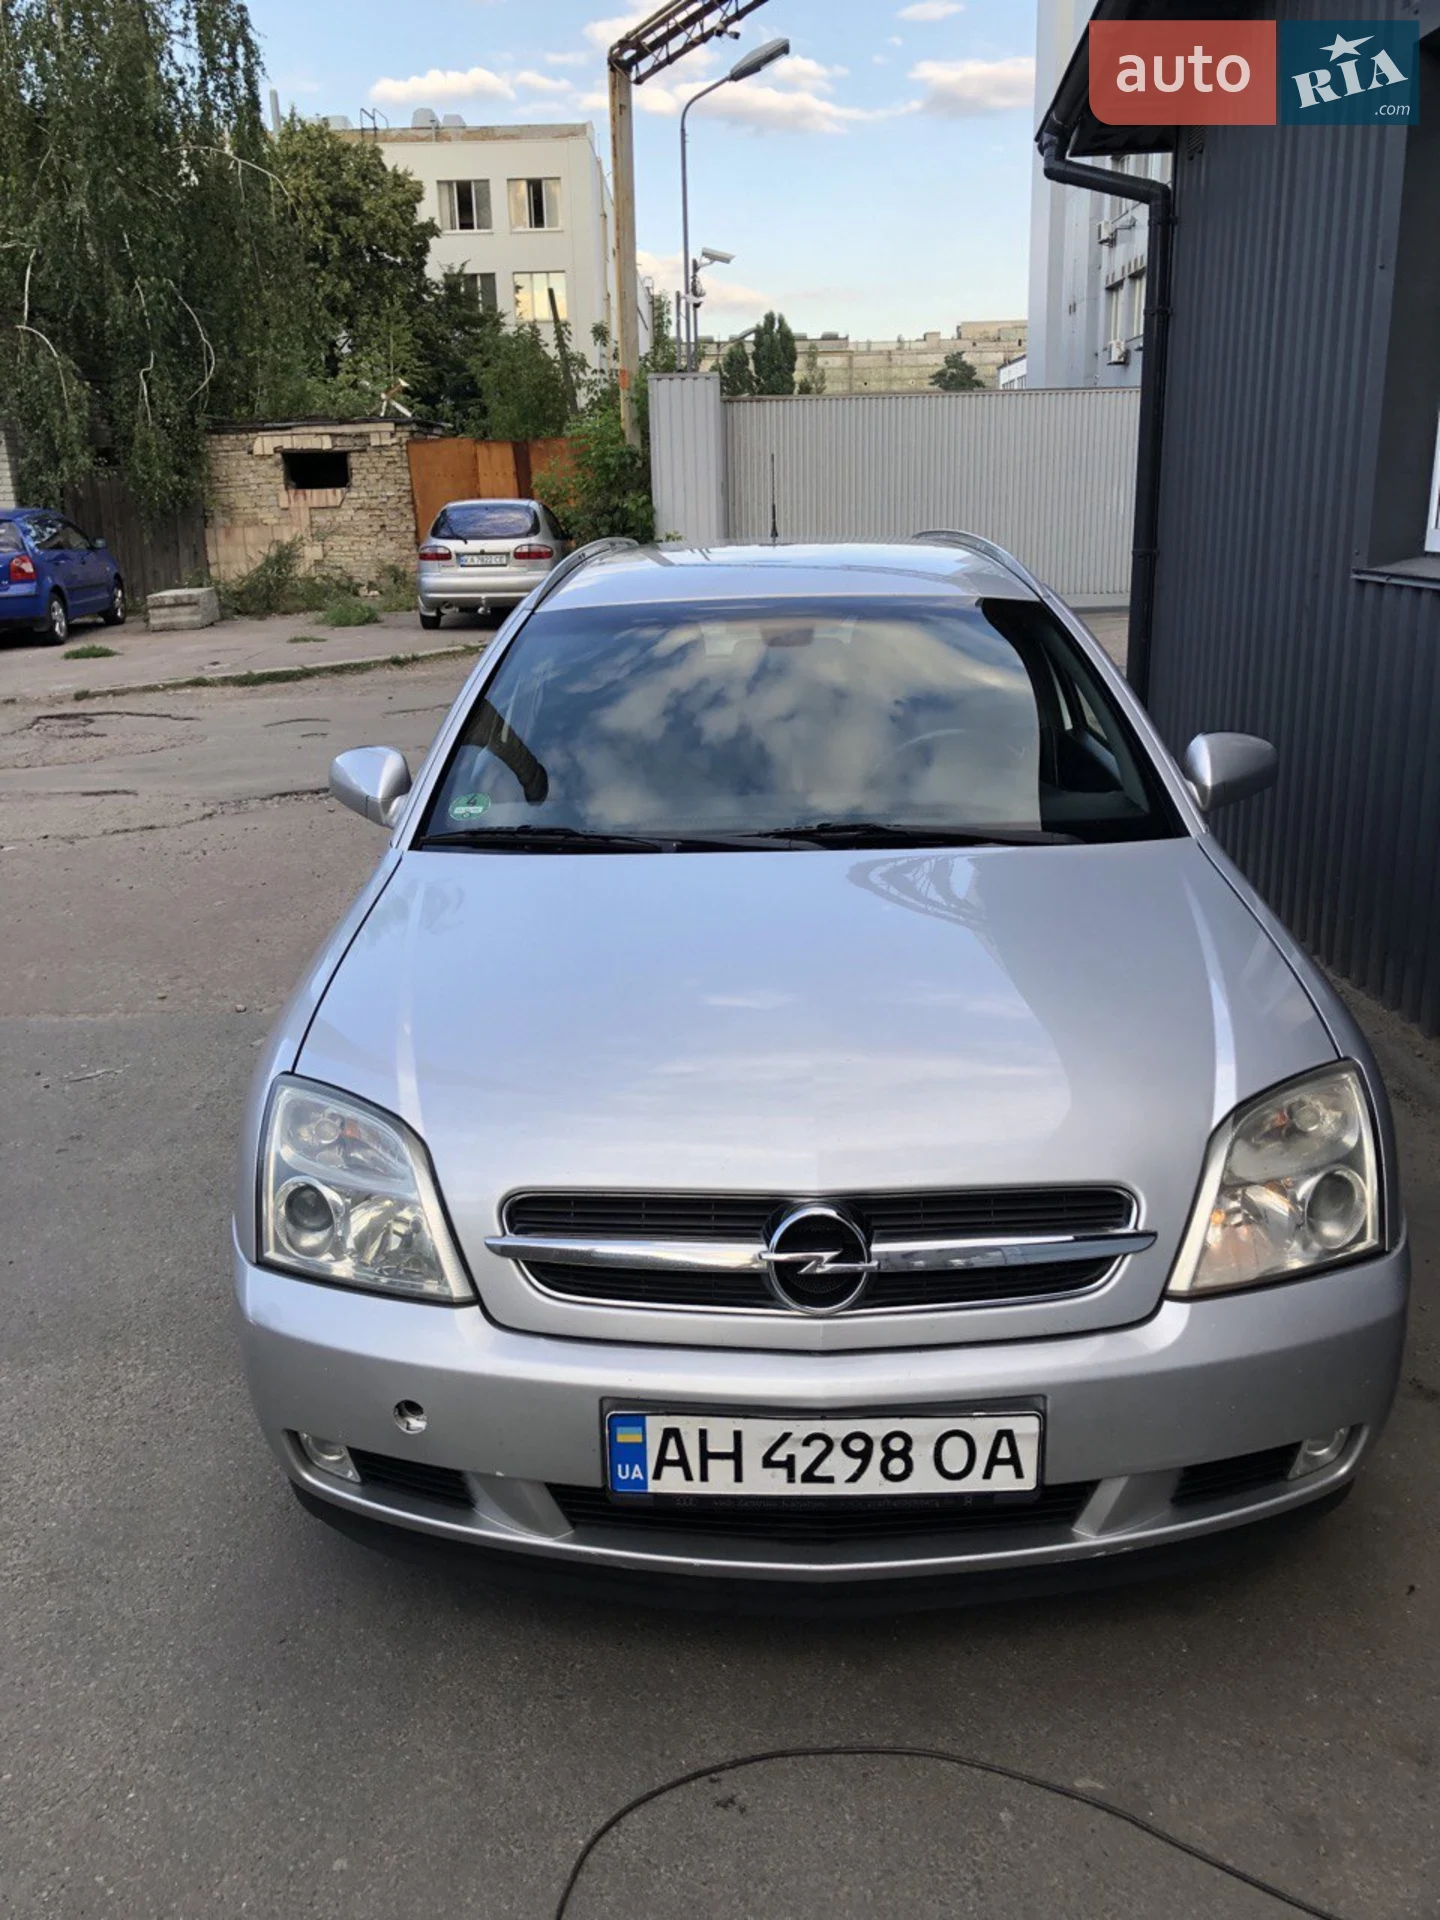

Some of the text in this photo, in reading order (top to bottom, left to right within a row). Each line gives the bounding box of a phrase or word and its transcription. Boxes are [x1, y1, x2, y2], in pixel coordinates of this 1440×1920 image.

[617, 1463, 645, 1480] UA
[651, 1426, 1026, 1484] AH 4298 OA
